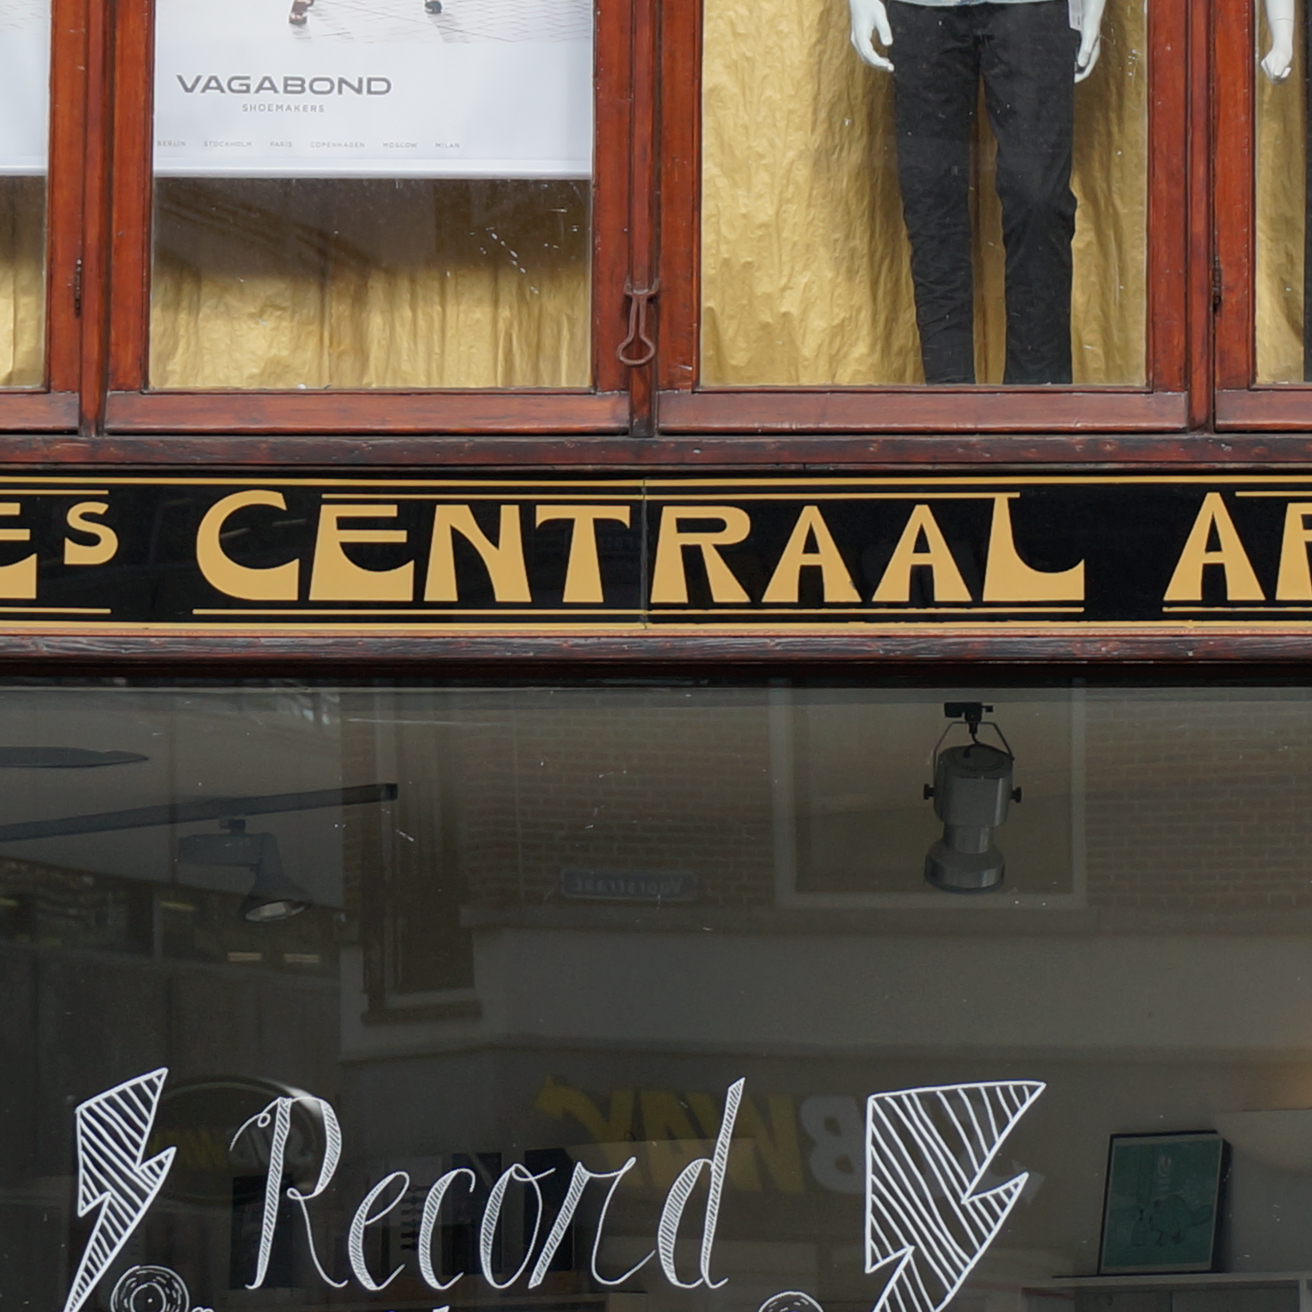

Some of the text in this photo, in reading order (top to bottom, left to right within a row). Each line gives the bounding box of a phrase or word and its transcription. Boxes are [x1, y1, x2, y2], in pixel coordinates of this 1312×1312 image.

[175, 74, 392, 96] VAGABOND
[241, 102, 326, 114] SHOEMAKERS
[195, 490, 1085, 603] CENTRAAL
[229, 1076, 745, 1291] Record
